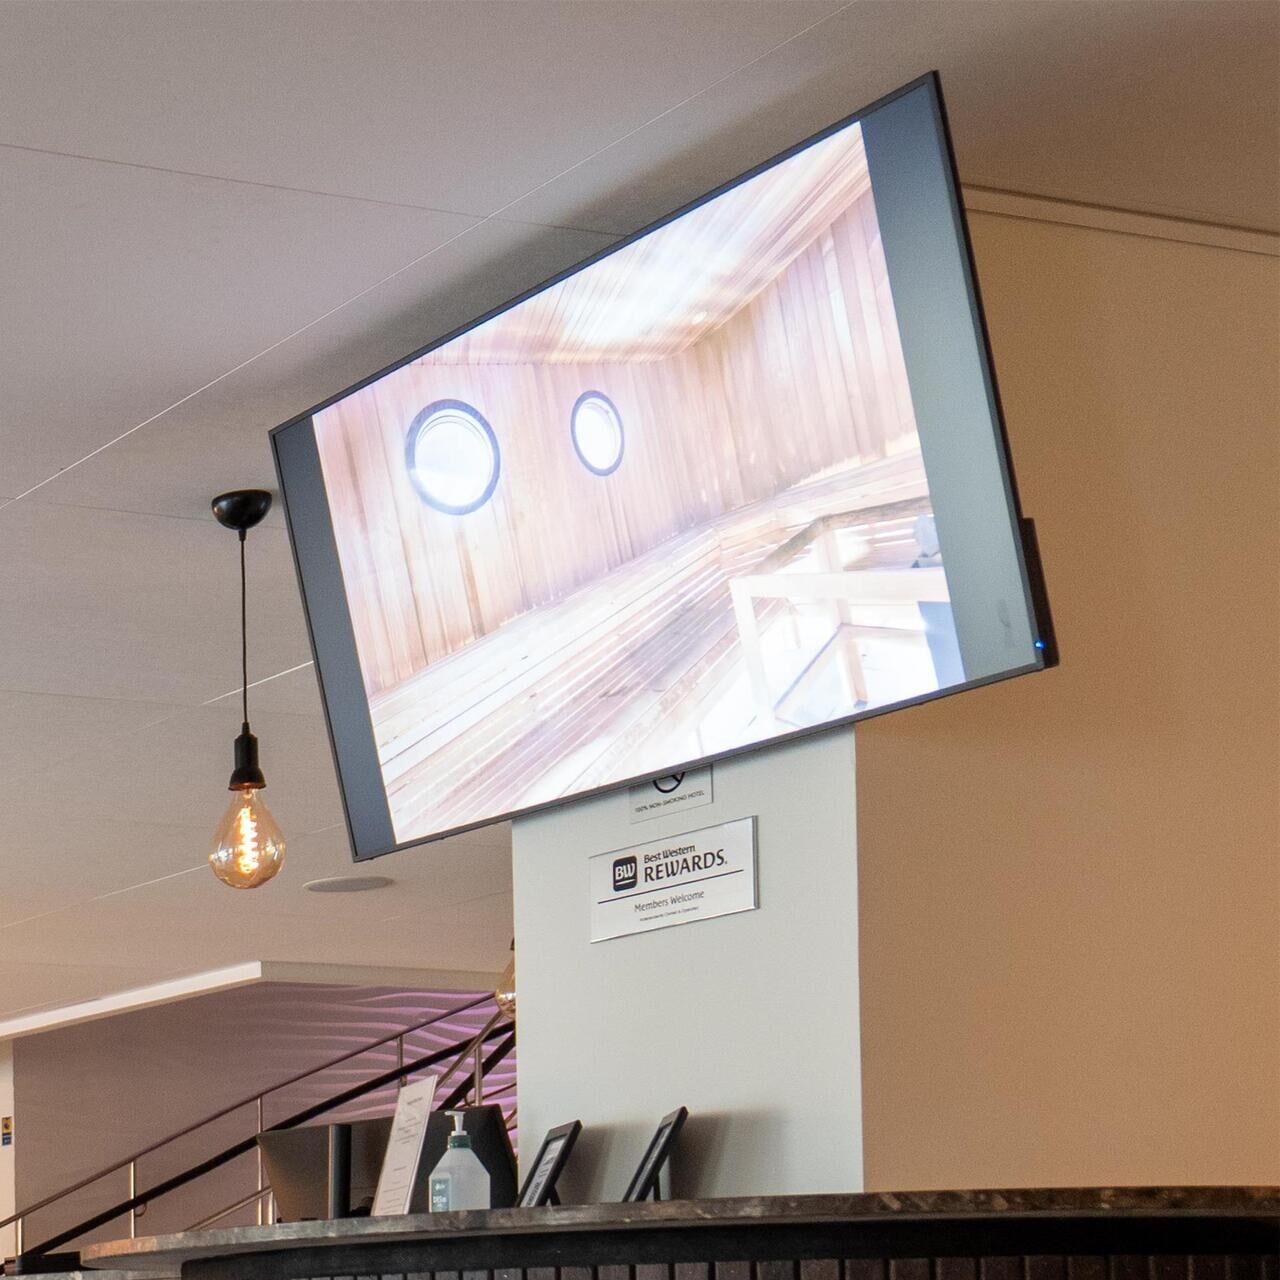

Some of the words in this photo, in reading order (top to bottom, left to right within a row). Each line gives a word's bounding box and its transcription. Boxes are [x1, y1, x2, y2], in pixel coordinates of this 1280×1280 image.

[688, 790, 705, 799] HOTEL
[644, 853, 662, 863] Best
[663, 845, 696, 859] Western
[615, 863, 636, 880] BW
[634, 898, 669, 912] Members
[670, 891, 705, 904] Welcome
